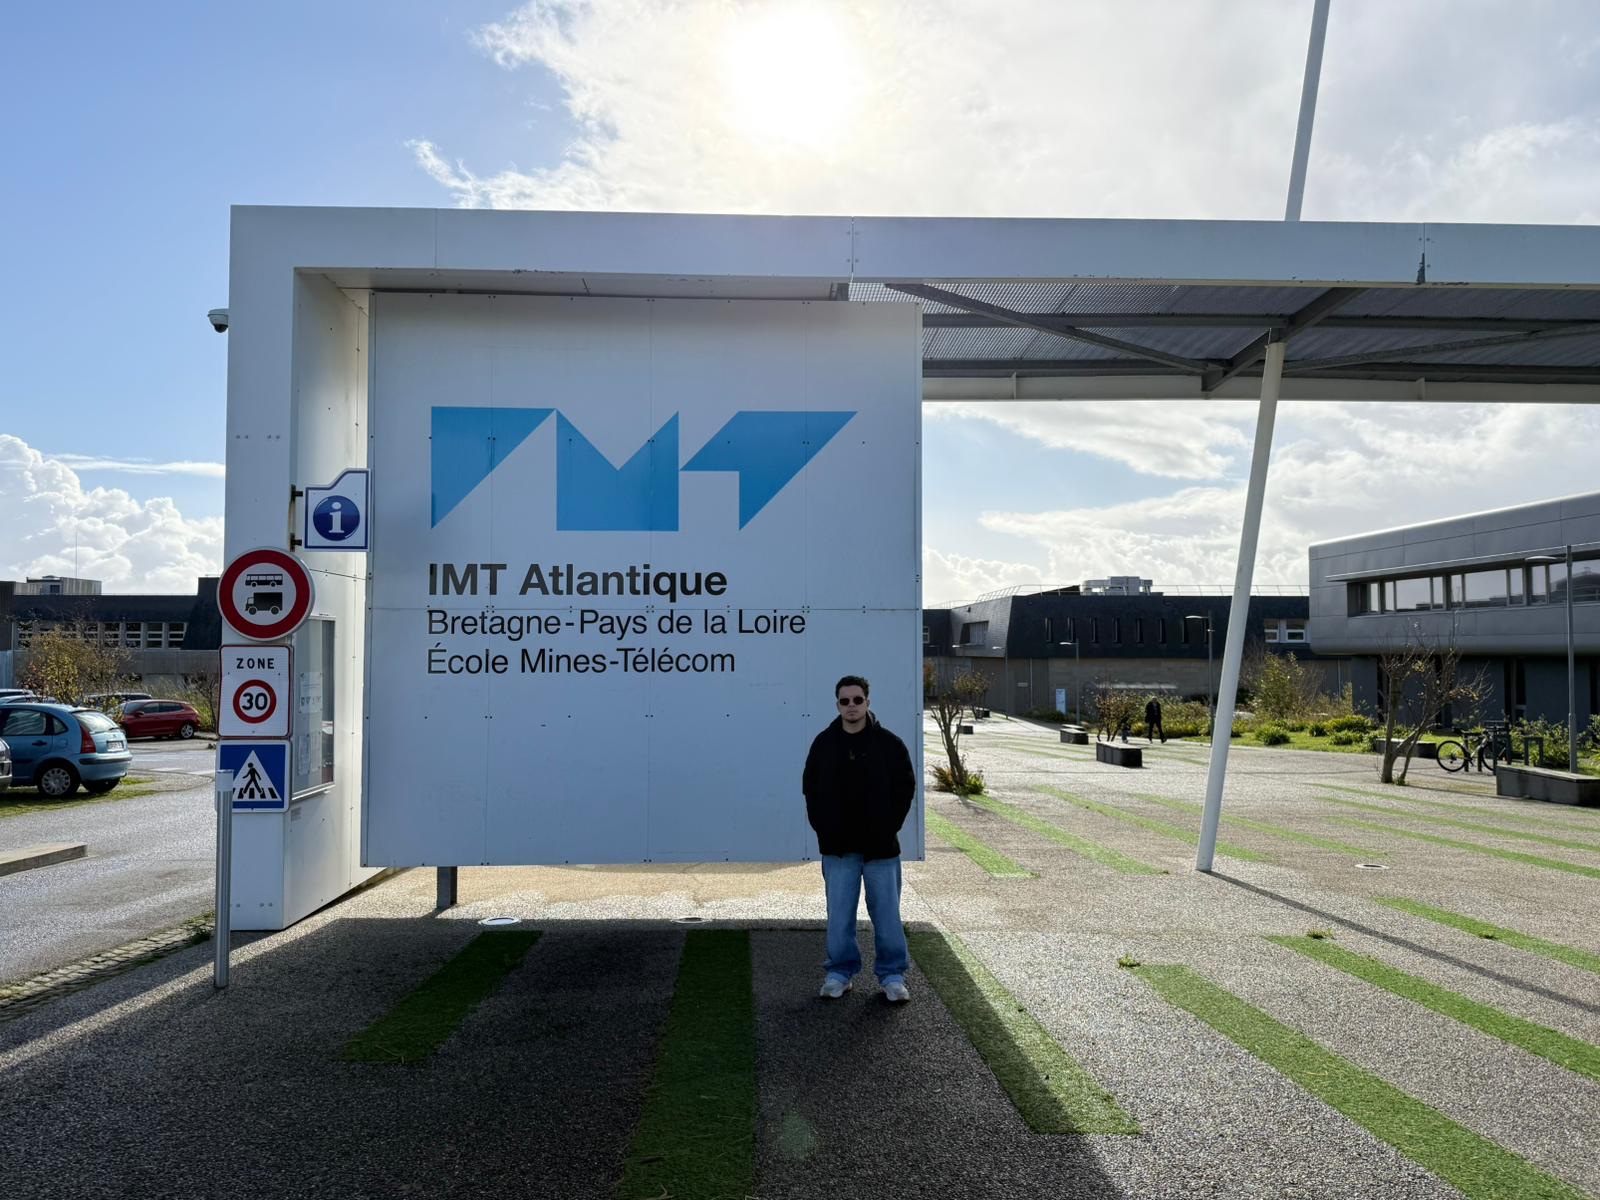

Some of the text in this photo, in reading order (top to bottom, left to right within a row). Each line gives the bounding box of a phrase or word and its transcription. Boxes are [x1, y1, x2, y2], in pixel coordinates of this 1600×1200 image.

[428, 563, 728, 604] IMT Atlantique
[426, 608, 807, 642] Bretagne-Pays de la Loire
[235, 657, 275, 670] ZONE
[427, 641, 736, 675] École Mines-Télécom
[241, 692, 268, 711] 30
